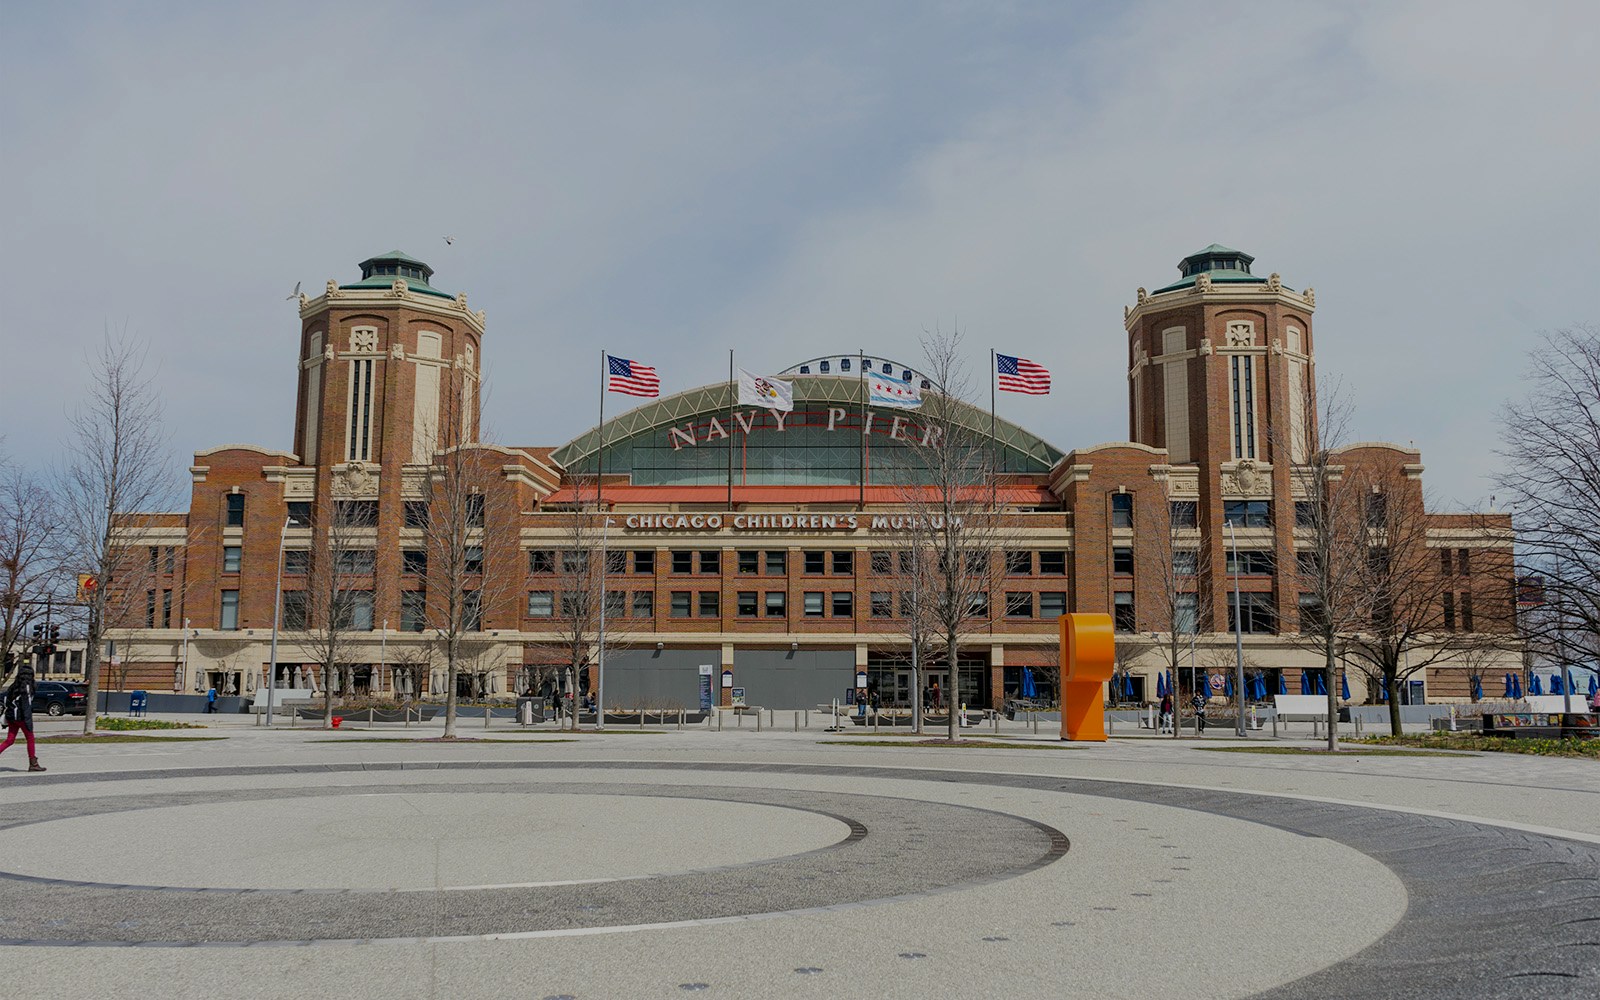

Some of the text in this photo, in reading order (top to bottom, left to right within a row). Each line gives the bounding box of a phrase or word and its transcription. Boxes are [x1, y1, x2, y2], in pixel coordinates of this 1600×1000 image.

[668, 407, 945, 451] NAVY PIER
[626, 514, 722, 529] CHICAGO
[733, 514, 859, 529] CHILDREN'S
